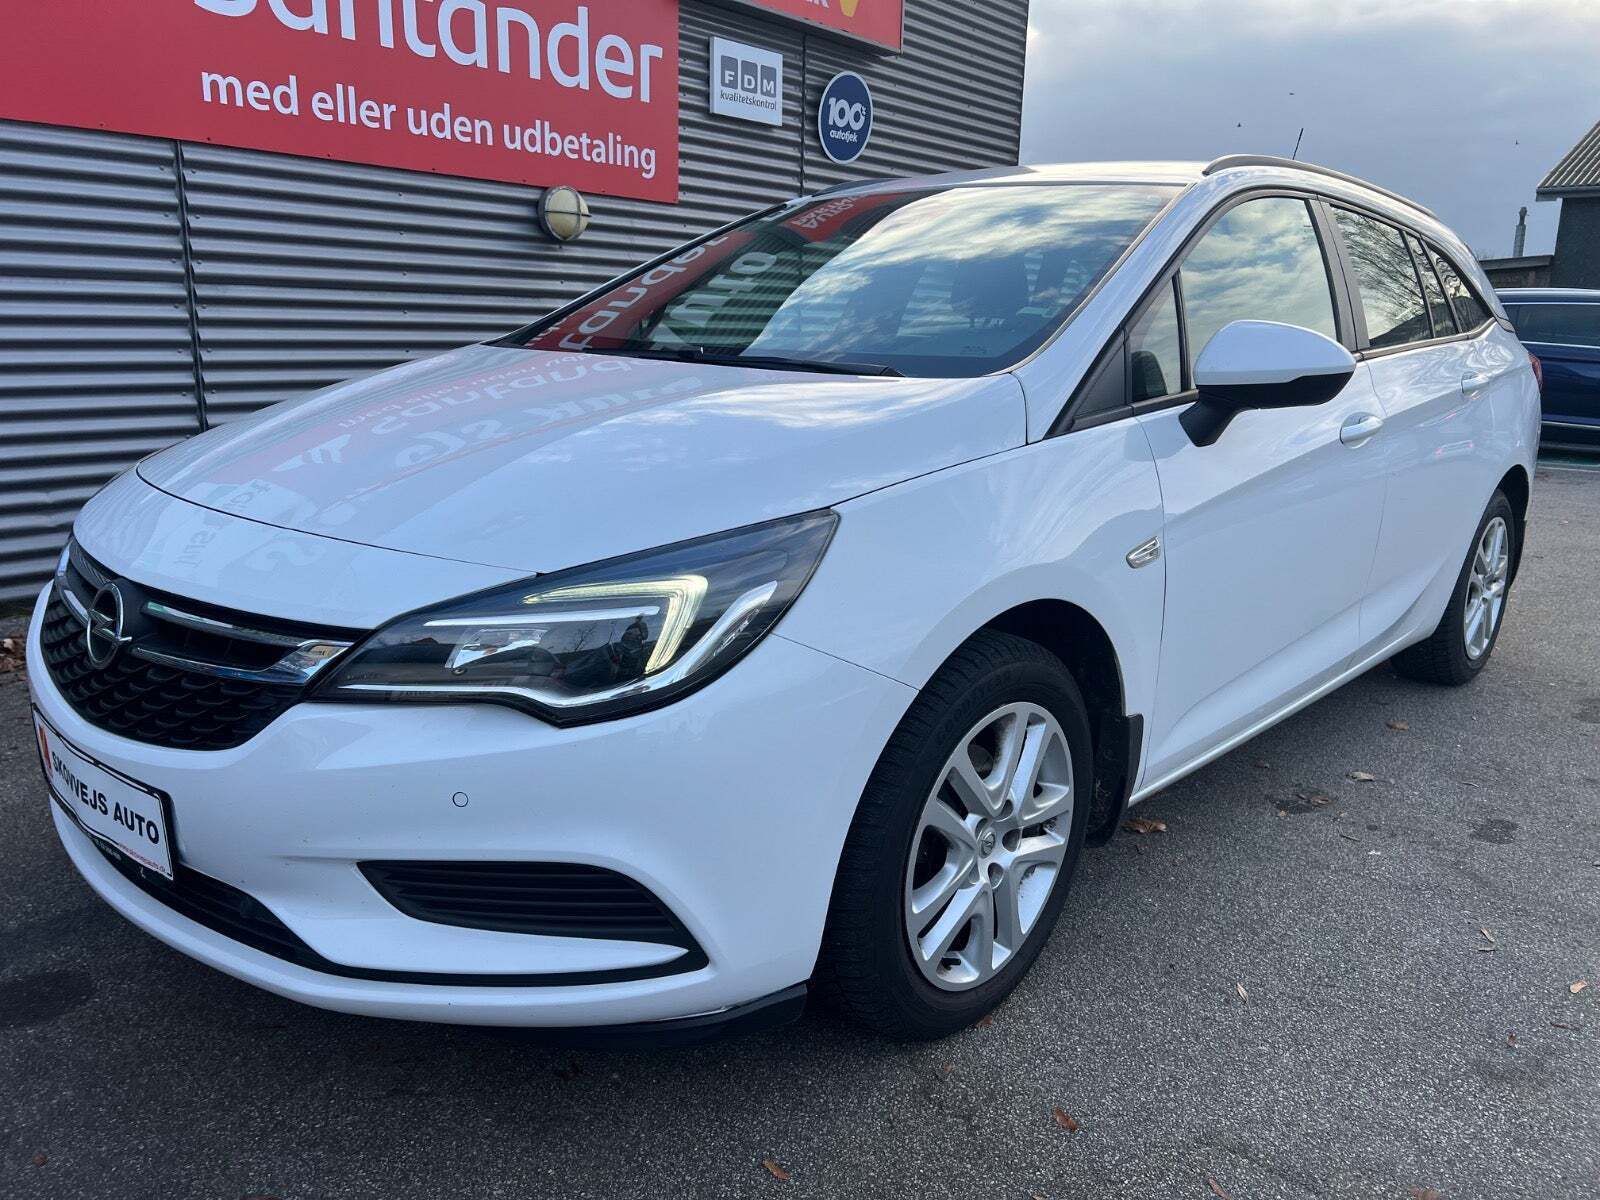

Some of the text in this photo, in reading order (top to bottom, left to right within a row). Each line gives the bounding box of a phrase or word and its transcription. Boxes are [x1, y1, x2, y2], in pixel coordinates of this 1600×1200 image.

[724, 70, 775, 95] FDM
[720, 89, 778, 111] kvalitetskontrol
[201, 71, 657, 179] med eller uden udbetaling
[113, 802, 160, 845] AUTO
